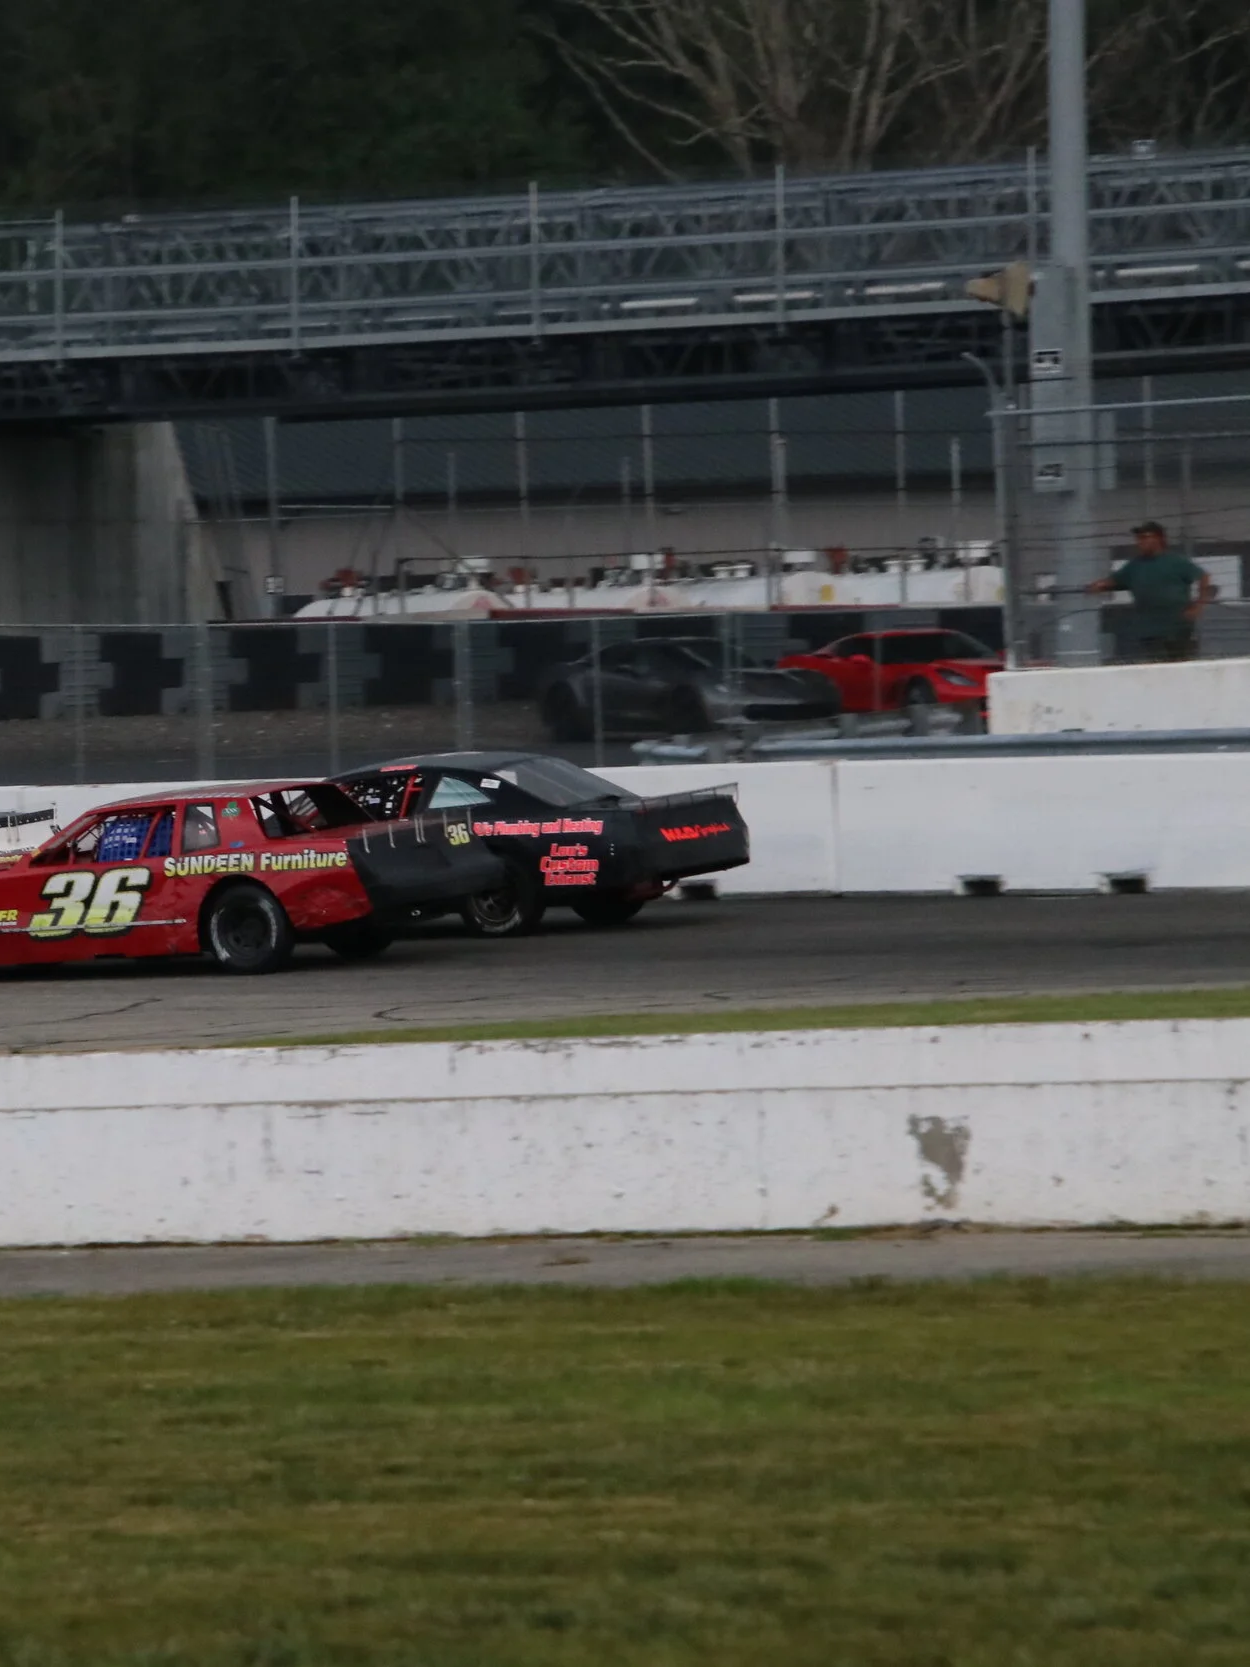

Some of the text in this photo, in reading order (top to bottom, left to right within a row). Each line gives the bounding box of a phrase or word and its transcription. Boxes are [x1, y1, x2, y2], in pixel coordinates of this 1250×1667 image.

[447, 823, 470, 845] 36
[163, 848, 348, 877] SUNDEEN Furniture
[540, 856, 599, 873] Custom
[545, 872, 596, 886] Exhaust
[27, 866, 153, 938] 36
